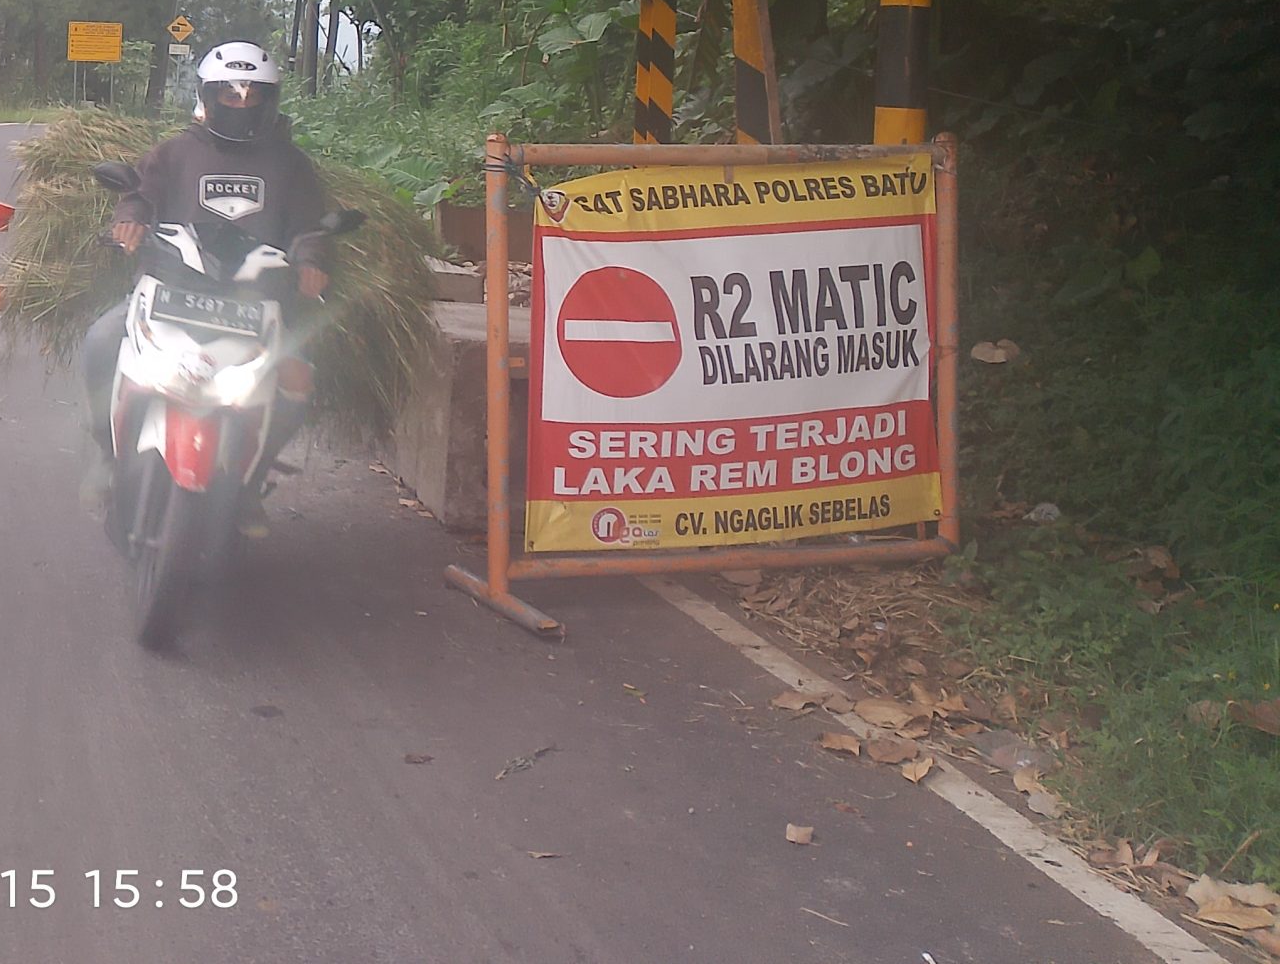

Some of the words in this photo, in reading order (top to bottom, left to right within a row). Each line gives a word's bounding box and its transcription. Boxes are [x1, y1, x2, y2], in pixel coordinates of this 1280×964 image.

[207, 183, 257, 194] ROCKET
[630, 177, 750, 212] SABHARA
[756, 175, 855, 205] POLRES
[865, 171, 927, 199] BATU
[691, 272, 757, 340] R2
[769, 260, 918, 335] MATIC
[698, 337, 829, 385] DILARANG
[837, 328, 920, 374] MASUK
[568, 428, 736, 459] SERING
[749, 409, 907, 452] TERJADI
[552, 466, 675, 496] LAKA
[689, 459, 778, 492] REM
[791, 444, 917, 485] BLONG
[674, 511, 707, 536] CV.
[713, 504, 804, 535] NGAGLIK
[809, 494, 890, 528] SEBELAS
